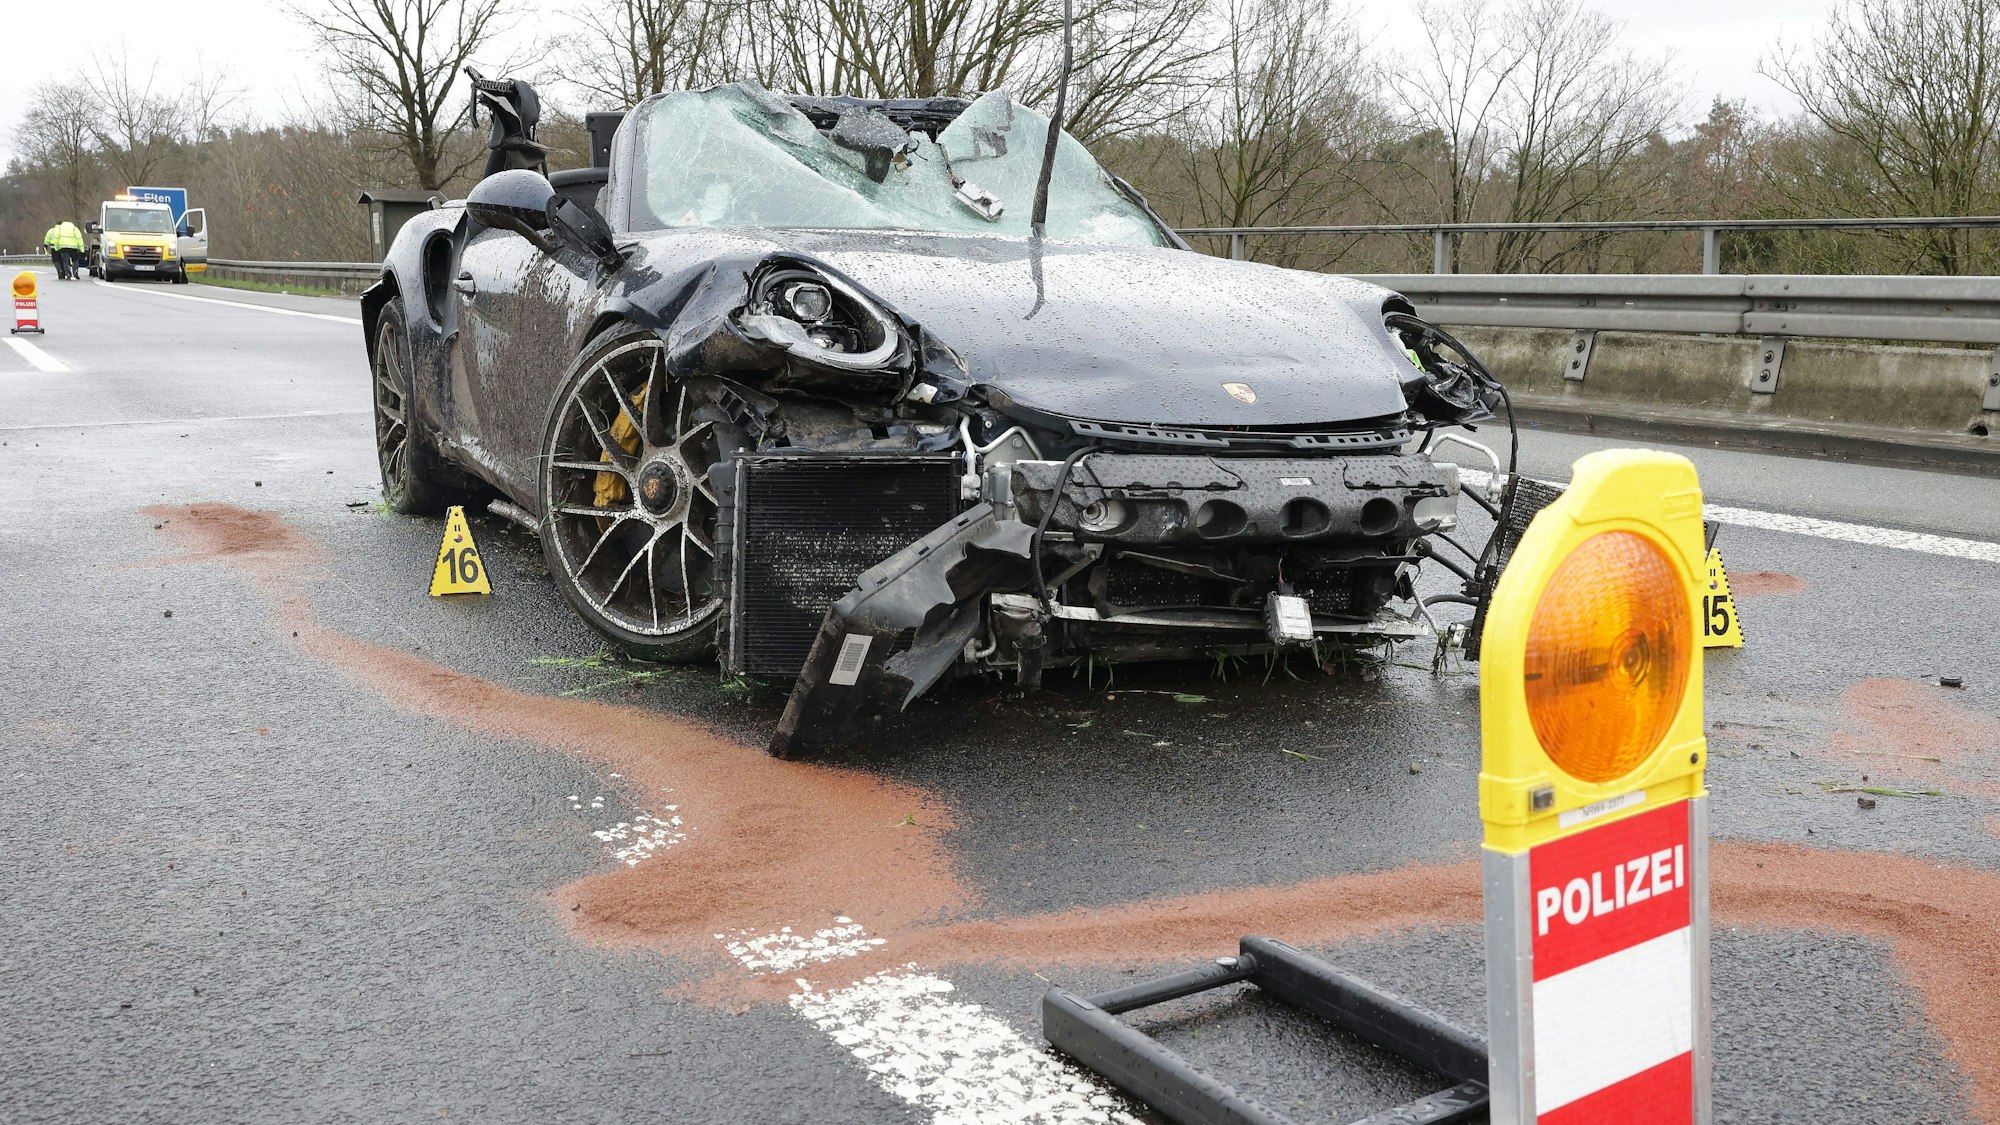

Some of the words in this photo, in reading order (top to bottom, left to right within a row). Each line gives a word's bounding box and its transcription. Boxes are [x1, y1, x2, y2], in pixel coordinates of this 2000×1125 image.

[144, 193, 171, 203] Elten
[442, 547, 479, 584] 16
[1703, 594, 1730, 636] 15
[1537, 843, 1685, 937] POLIZEI
